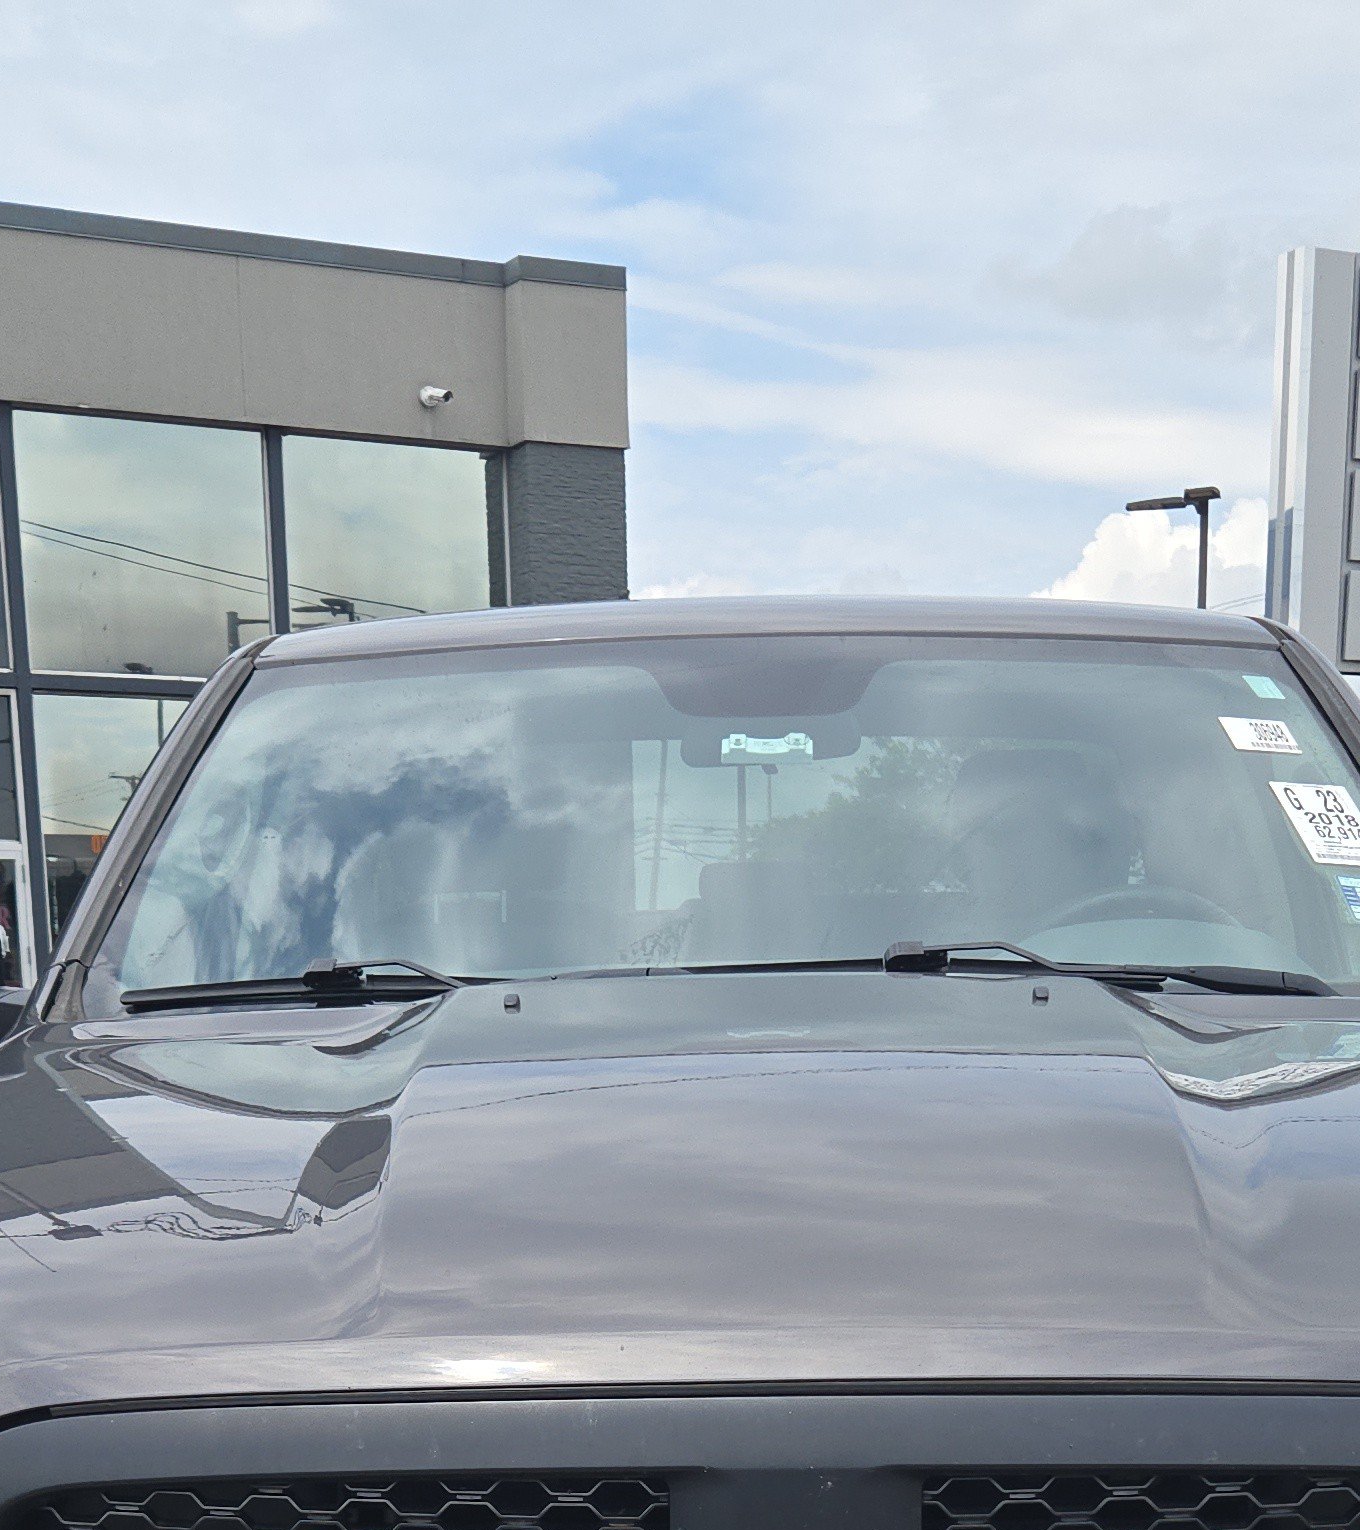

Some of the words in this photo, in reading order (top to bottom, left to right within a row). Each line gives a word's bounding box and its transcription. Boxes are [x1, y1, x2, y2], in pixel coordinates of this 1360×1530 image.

[1283, 787, 1305, 811] G
[1315, 789, 1345, 814] 23
[1303, 811, 1360, 828] 2018
